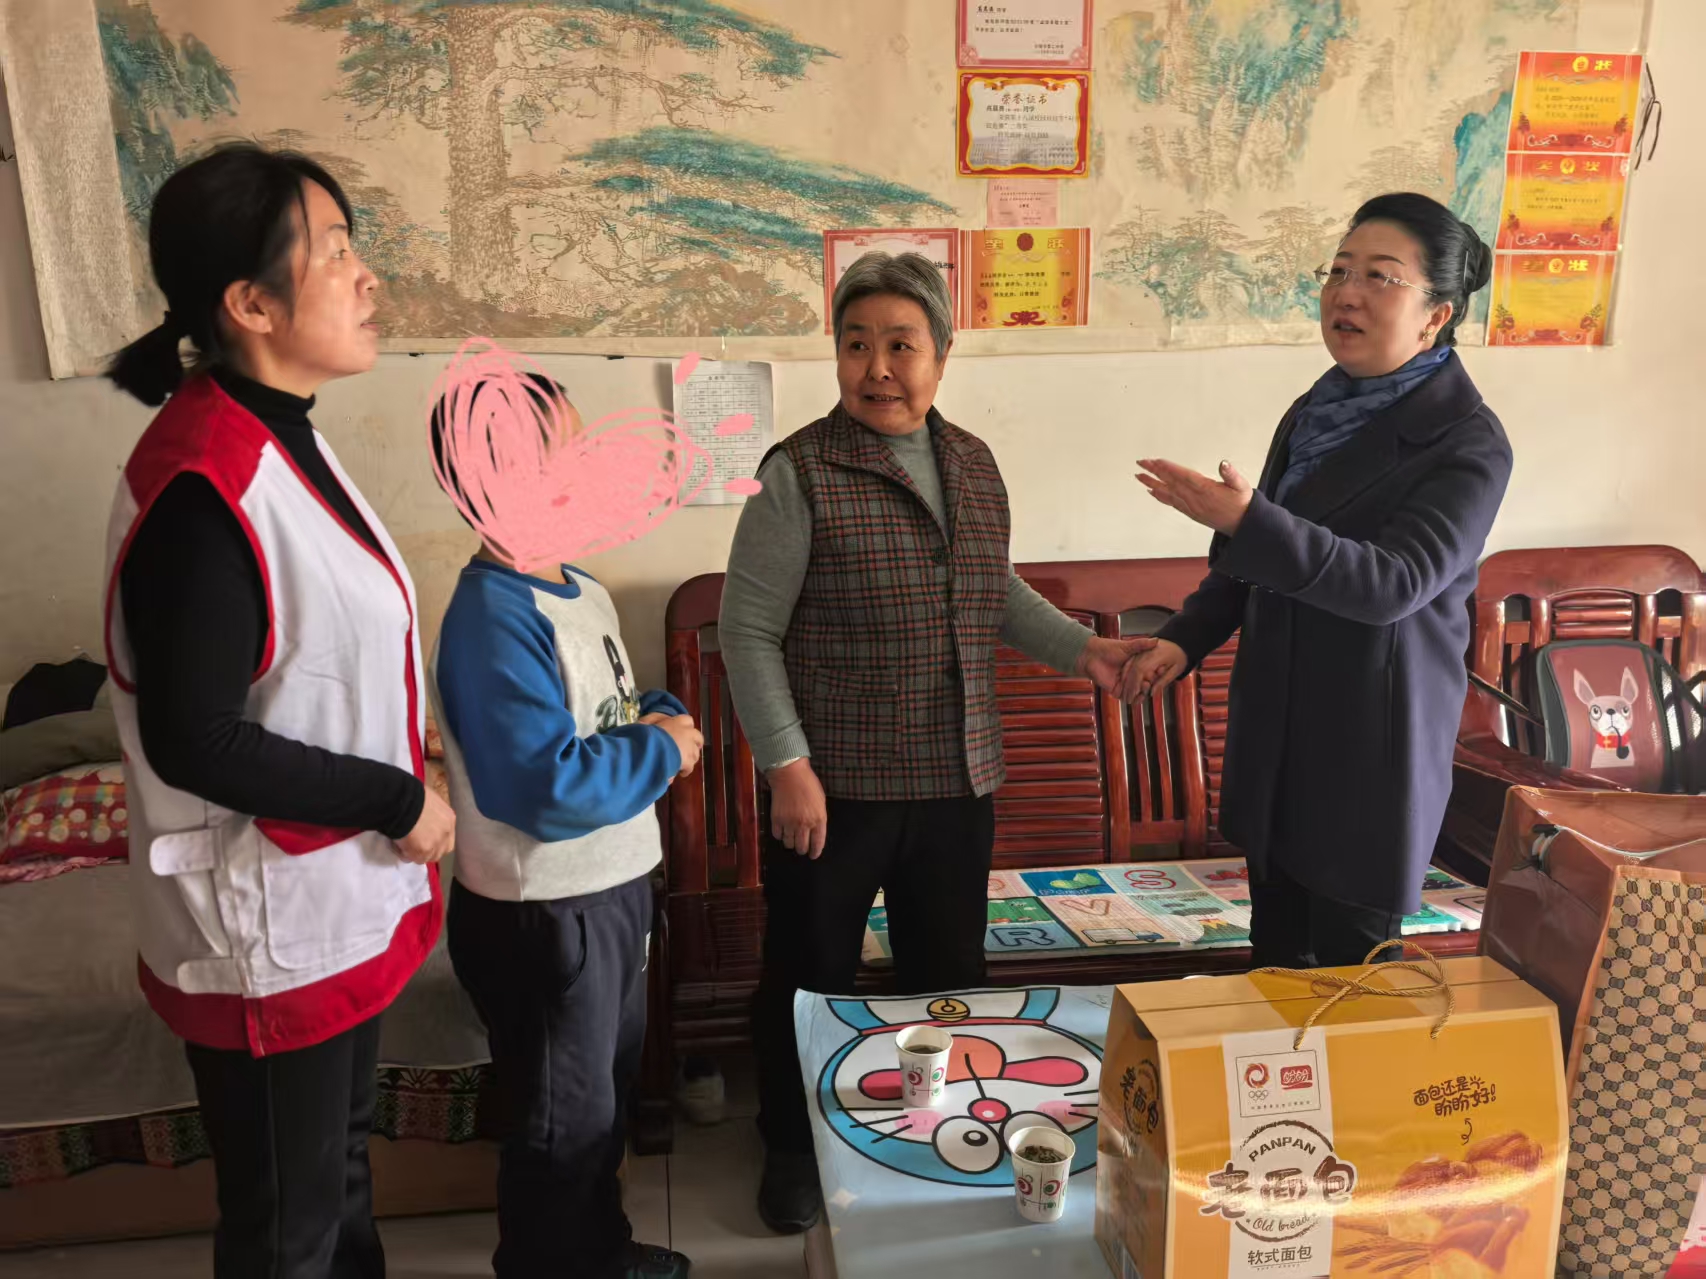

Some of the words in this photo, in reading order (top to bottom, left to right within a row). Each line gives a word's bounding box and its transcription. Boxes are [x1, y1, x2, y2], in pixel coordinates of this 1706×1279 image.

[990, 927, 1056, 947] R
[1413, 1076, 1471, 1106] 面包还是
[1249, 1136, 1316, 1162] PANPAN
[1253, 1217, 1274, 1231] Old
[1278, 1214, 1311, 1231] bread
[1247, 1245, 1313, 1265] 软式面包
